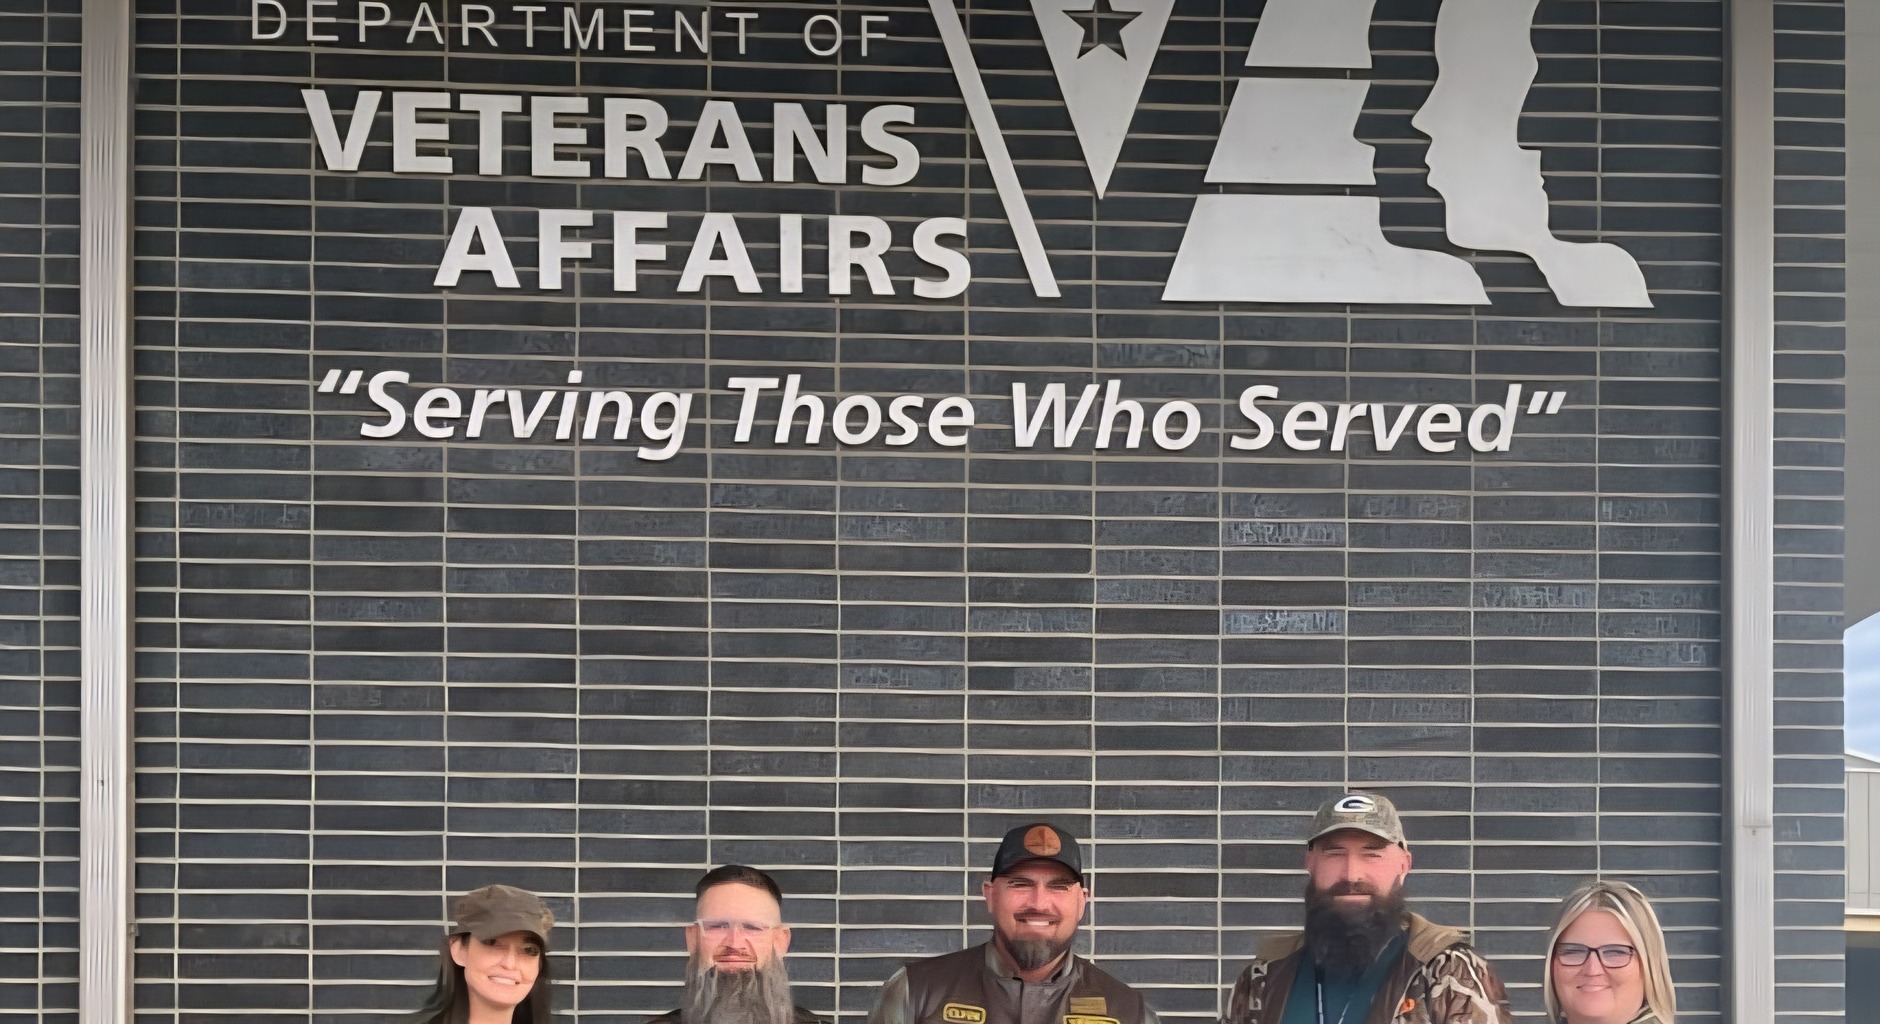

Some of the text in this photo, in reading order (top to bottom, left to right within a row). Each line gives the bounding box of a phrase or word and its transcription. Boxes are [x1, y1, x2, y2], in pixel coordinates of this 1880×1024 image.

[252, 0, 889, 57] DEPARTMENT OF
[302, 89, 922, 187] VETERANS
[433, 207, 973, 299] AFFAIRS
[727, 374, 976, 446] Those
[1011, 379, 1202, 451] Who
